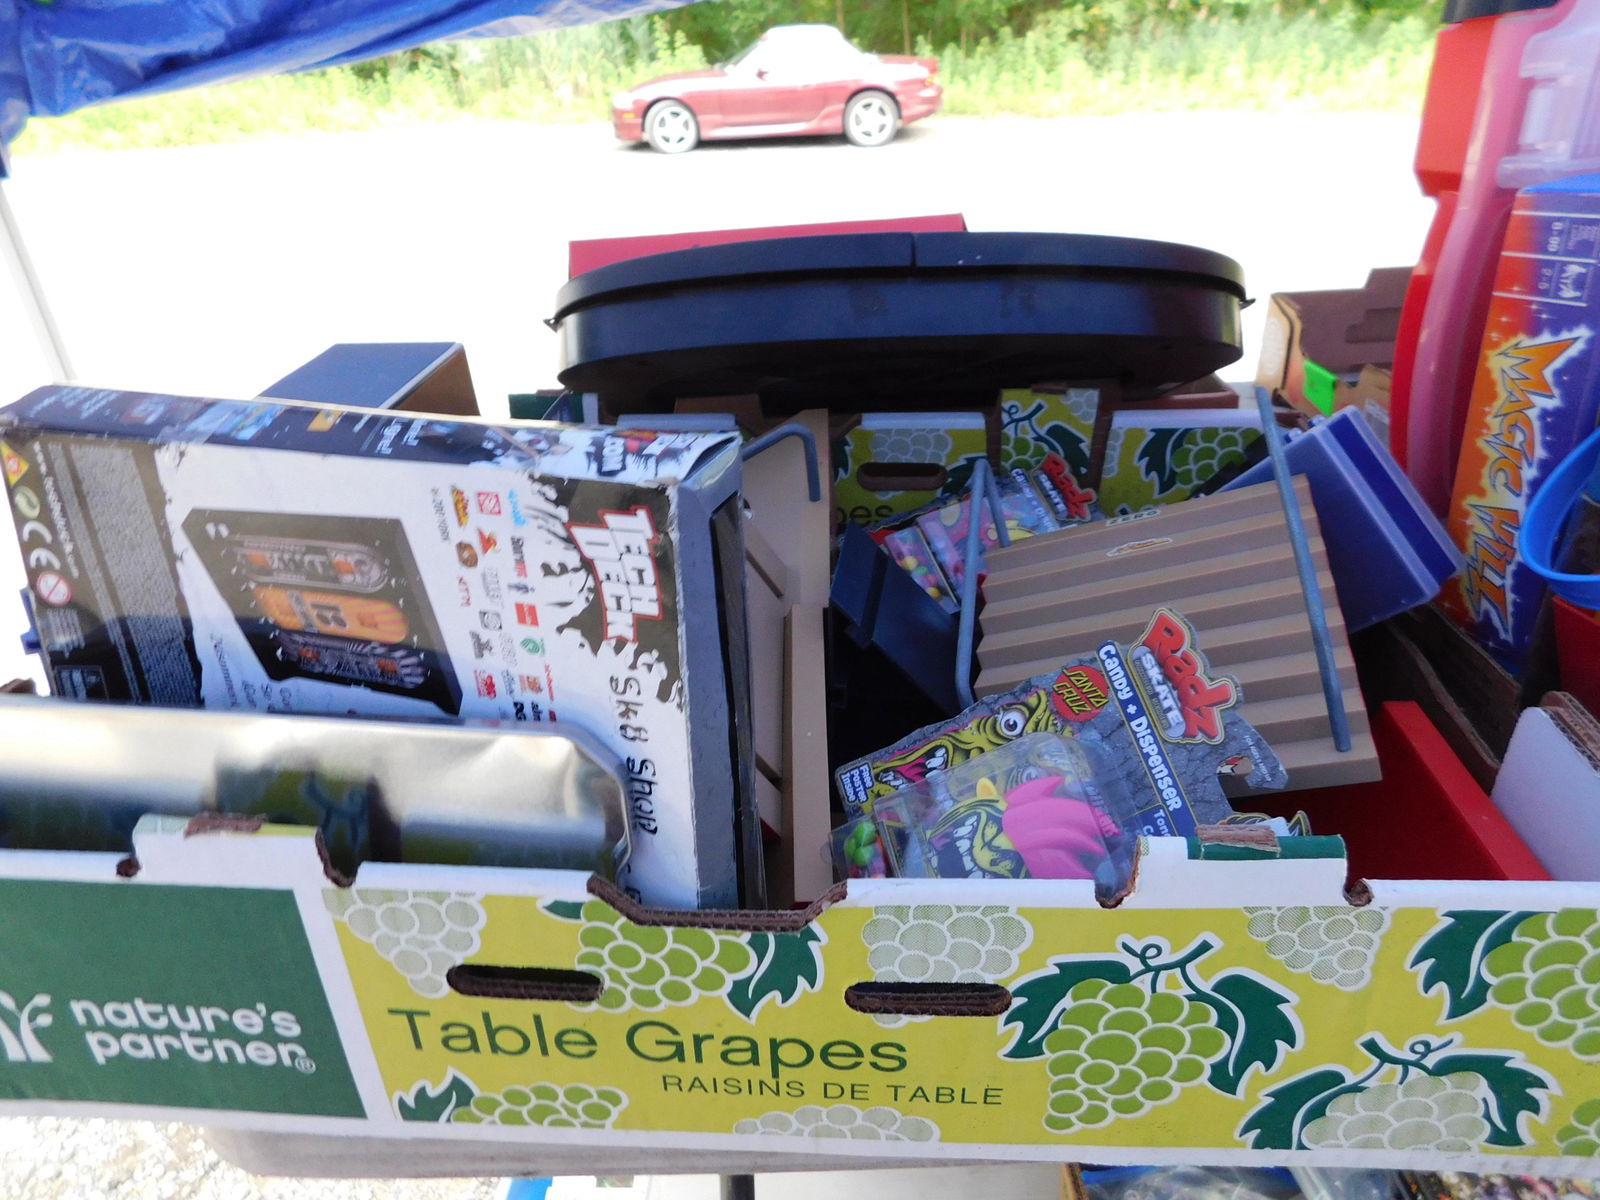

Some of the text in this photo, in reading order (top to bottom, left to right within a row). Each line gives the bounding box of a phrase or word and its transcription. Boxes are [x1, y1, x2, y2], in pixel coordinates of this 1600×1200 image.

[1485, 336, 1582, 497] MAGIC
[1044, 454, 1095, 518] Radz
[570, 524, 635, 641] DECK
[600, 506, 661, 619] TECH
[1053, 682, 1091, 714] CRUZ
[1062, 668, 1109, 708] SANTA
[1139, 652, 1184, 728] SKATE
[1144, 612, 1233, 739] Radz
[609, 677, 659, 835] Sk8 Shop
[1100, 643, 1131, 700] Candy
[1129, 718, 1185, 812] Dispenser
[849, 768, 868, 803] Poster
[857, 764, 874, 786] Free
[71, 998, 301, 1037] nature's
[387, 1008, 907, 1077] Table Grapes
[663, 1075, 1004, 1105] RAISINS DE TABLE
